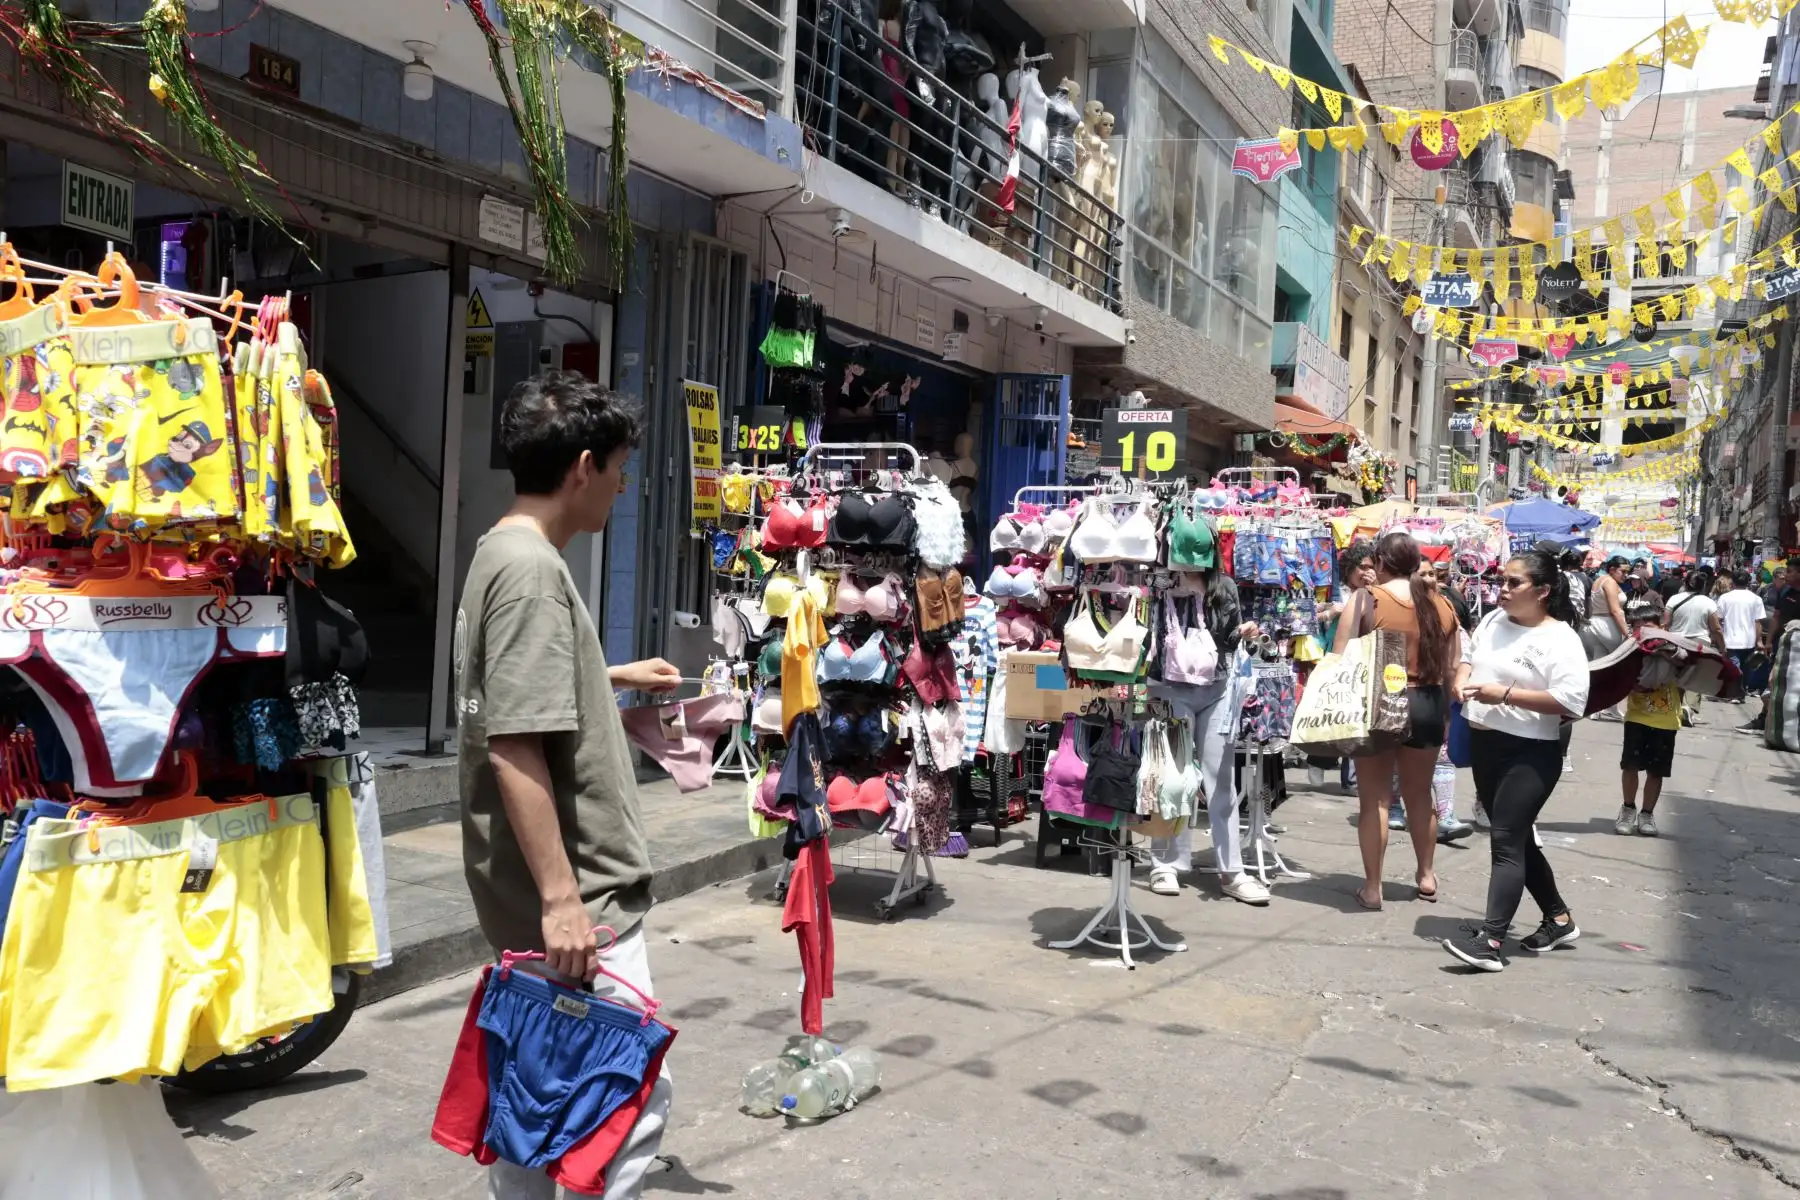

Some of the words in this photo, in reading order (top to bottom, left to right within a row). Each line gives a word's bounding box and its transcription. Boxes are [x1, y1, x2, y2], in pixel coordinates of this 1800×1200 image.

[68, 171, 129, 231] ENTRADA
[77, 330, 132, 362] Klein
[686, 388, 714, 411] BOLSAS
[698, 412, 703, 425] Y
[1121, 412, 1169, 421] OFERTA
[1118, 431, 1176, 472] 10
[95, 603, 172, 617] Russbelly
[190, 810, 269, 842] Klein
